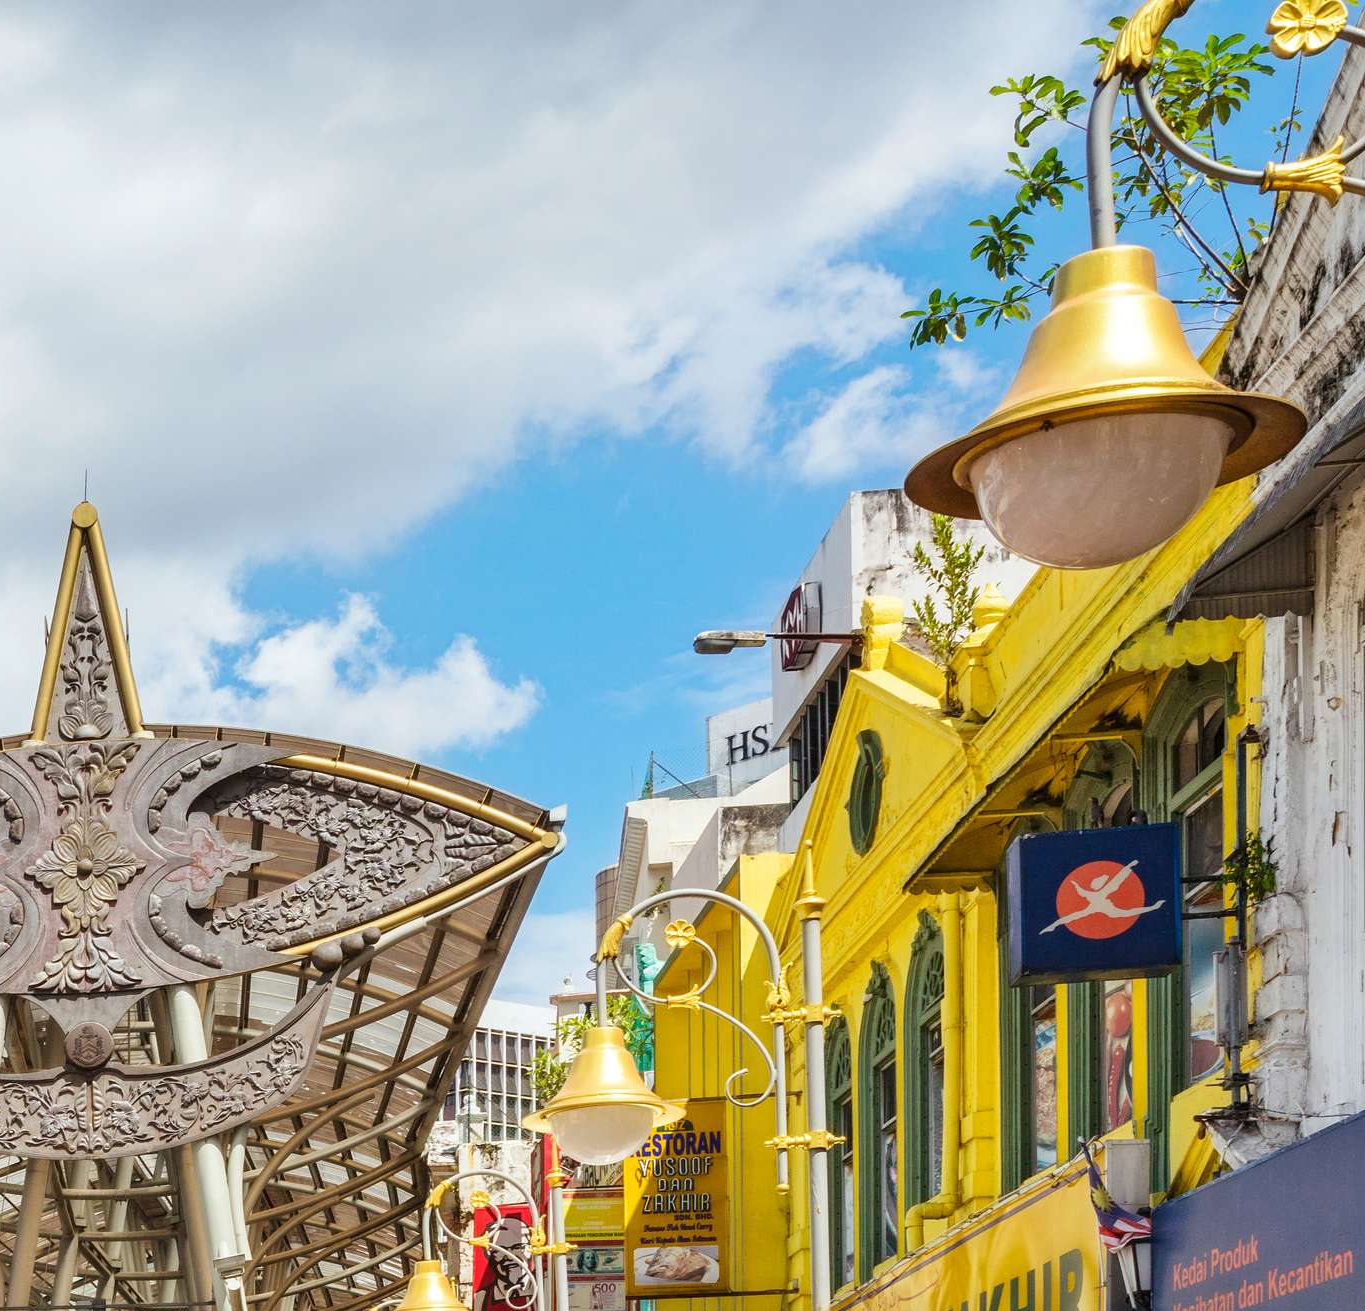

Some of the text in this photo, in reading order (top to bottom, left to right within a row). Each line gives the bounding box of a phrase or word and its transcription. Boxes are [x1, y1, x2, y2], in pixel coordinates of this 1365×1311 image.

[725, 723, 772, 766] HS
[631, 1131, 721, 1157] ESTORAN
[638, 1156, 713, 1176] YUSOOF
[658, 1178, 693, 1192] DAN
[642, 1193, 710, 1213] ZAKHIR
[1173, 1233, 1260, 1291] Kedai Produk
[594, 1283, 616, 1294] 500
[1238, 1280, 1264, 1309] dan
[1269, 1250, 1354, 1300] Kecantikan
